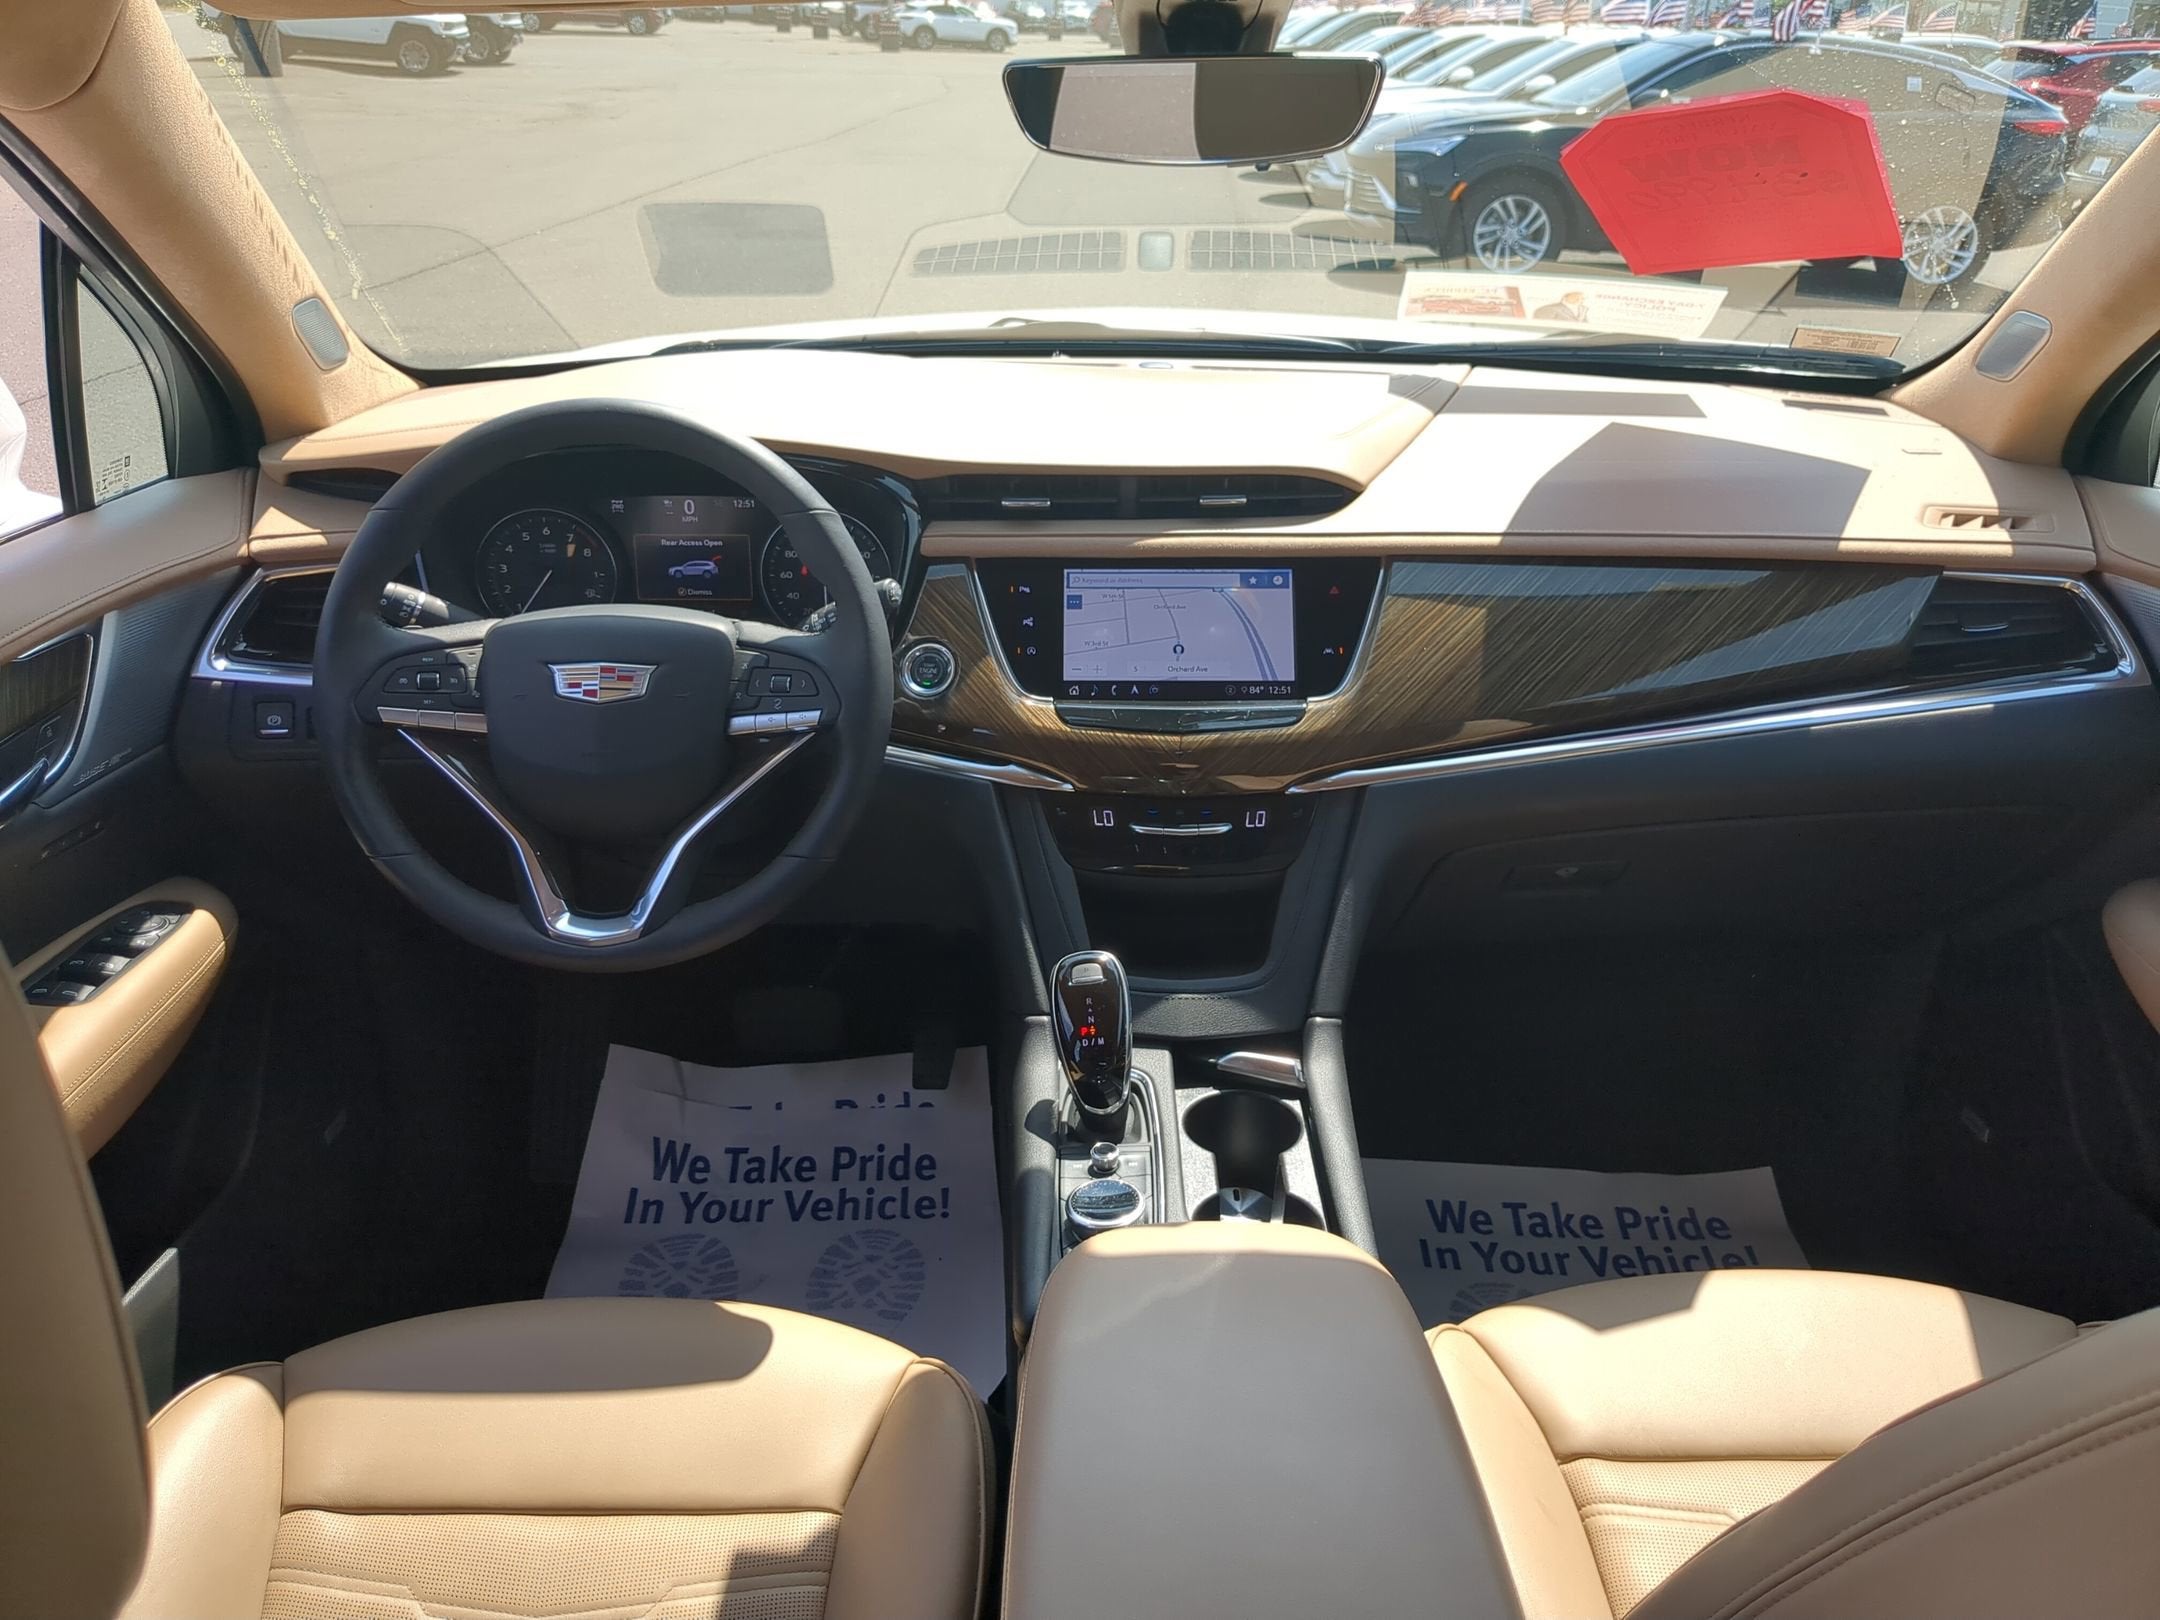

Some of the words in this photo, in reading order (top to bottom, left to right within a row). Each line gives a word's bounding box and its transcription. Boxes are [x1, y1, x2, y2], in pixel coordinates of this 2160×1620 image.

[683, 499, 696, 516] 0
[733, 500, 755, 509] 12:51
[542, 526, 551, 536] 6
[521, 532, 531, 541] 5
[566, 533, 575, 543] 7
[703, 539, 723, 548] Open
[504, 544, 514, 554] 4
[583, 548, 592, 558] 8
[784, 550, 798, 559] 80
[498, 564, 508, 573] 3
[779, 571, 793, 579] 60
[503, 585, 512, 594] 2
[786, 592, 800, 600] 40
[1167, 665, 1193, 673] Orchard
[1194, 665, 1208, 673] Ave
[1269, 685, 1291, 695] 12:51
[1093, 809, 1114, 827] LO
[1245, 810, 1266, 828] LO
[652, 1137, 711, 1184] We
[724, 1143, 817, 1185] Take
[832, 1143, 937, 1183] Pride
[623, 1187, 664, 1225] In
[679, 1191, 775, 1225] Your
[784, 1187, 950, 1223] Vehicle!
[1425, 1198, 1494, 1236] We
[1501, 1201, 1604, 1239] Take
[1615, 1205, 1731, 1241] Pride
[1419, 1239, 1462, 1270] In
[1471, 1241, 1570, 1276] Your
